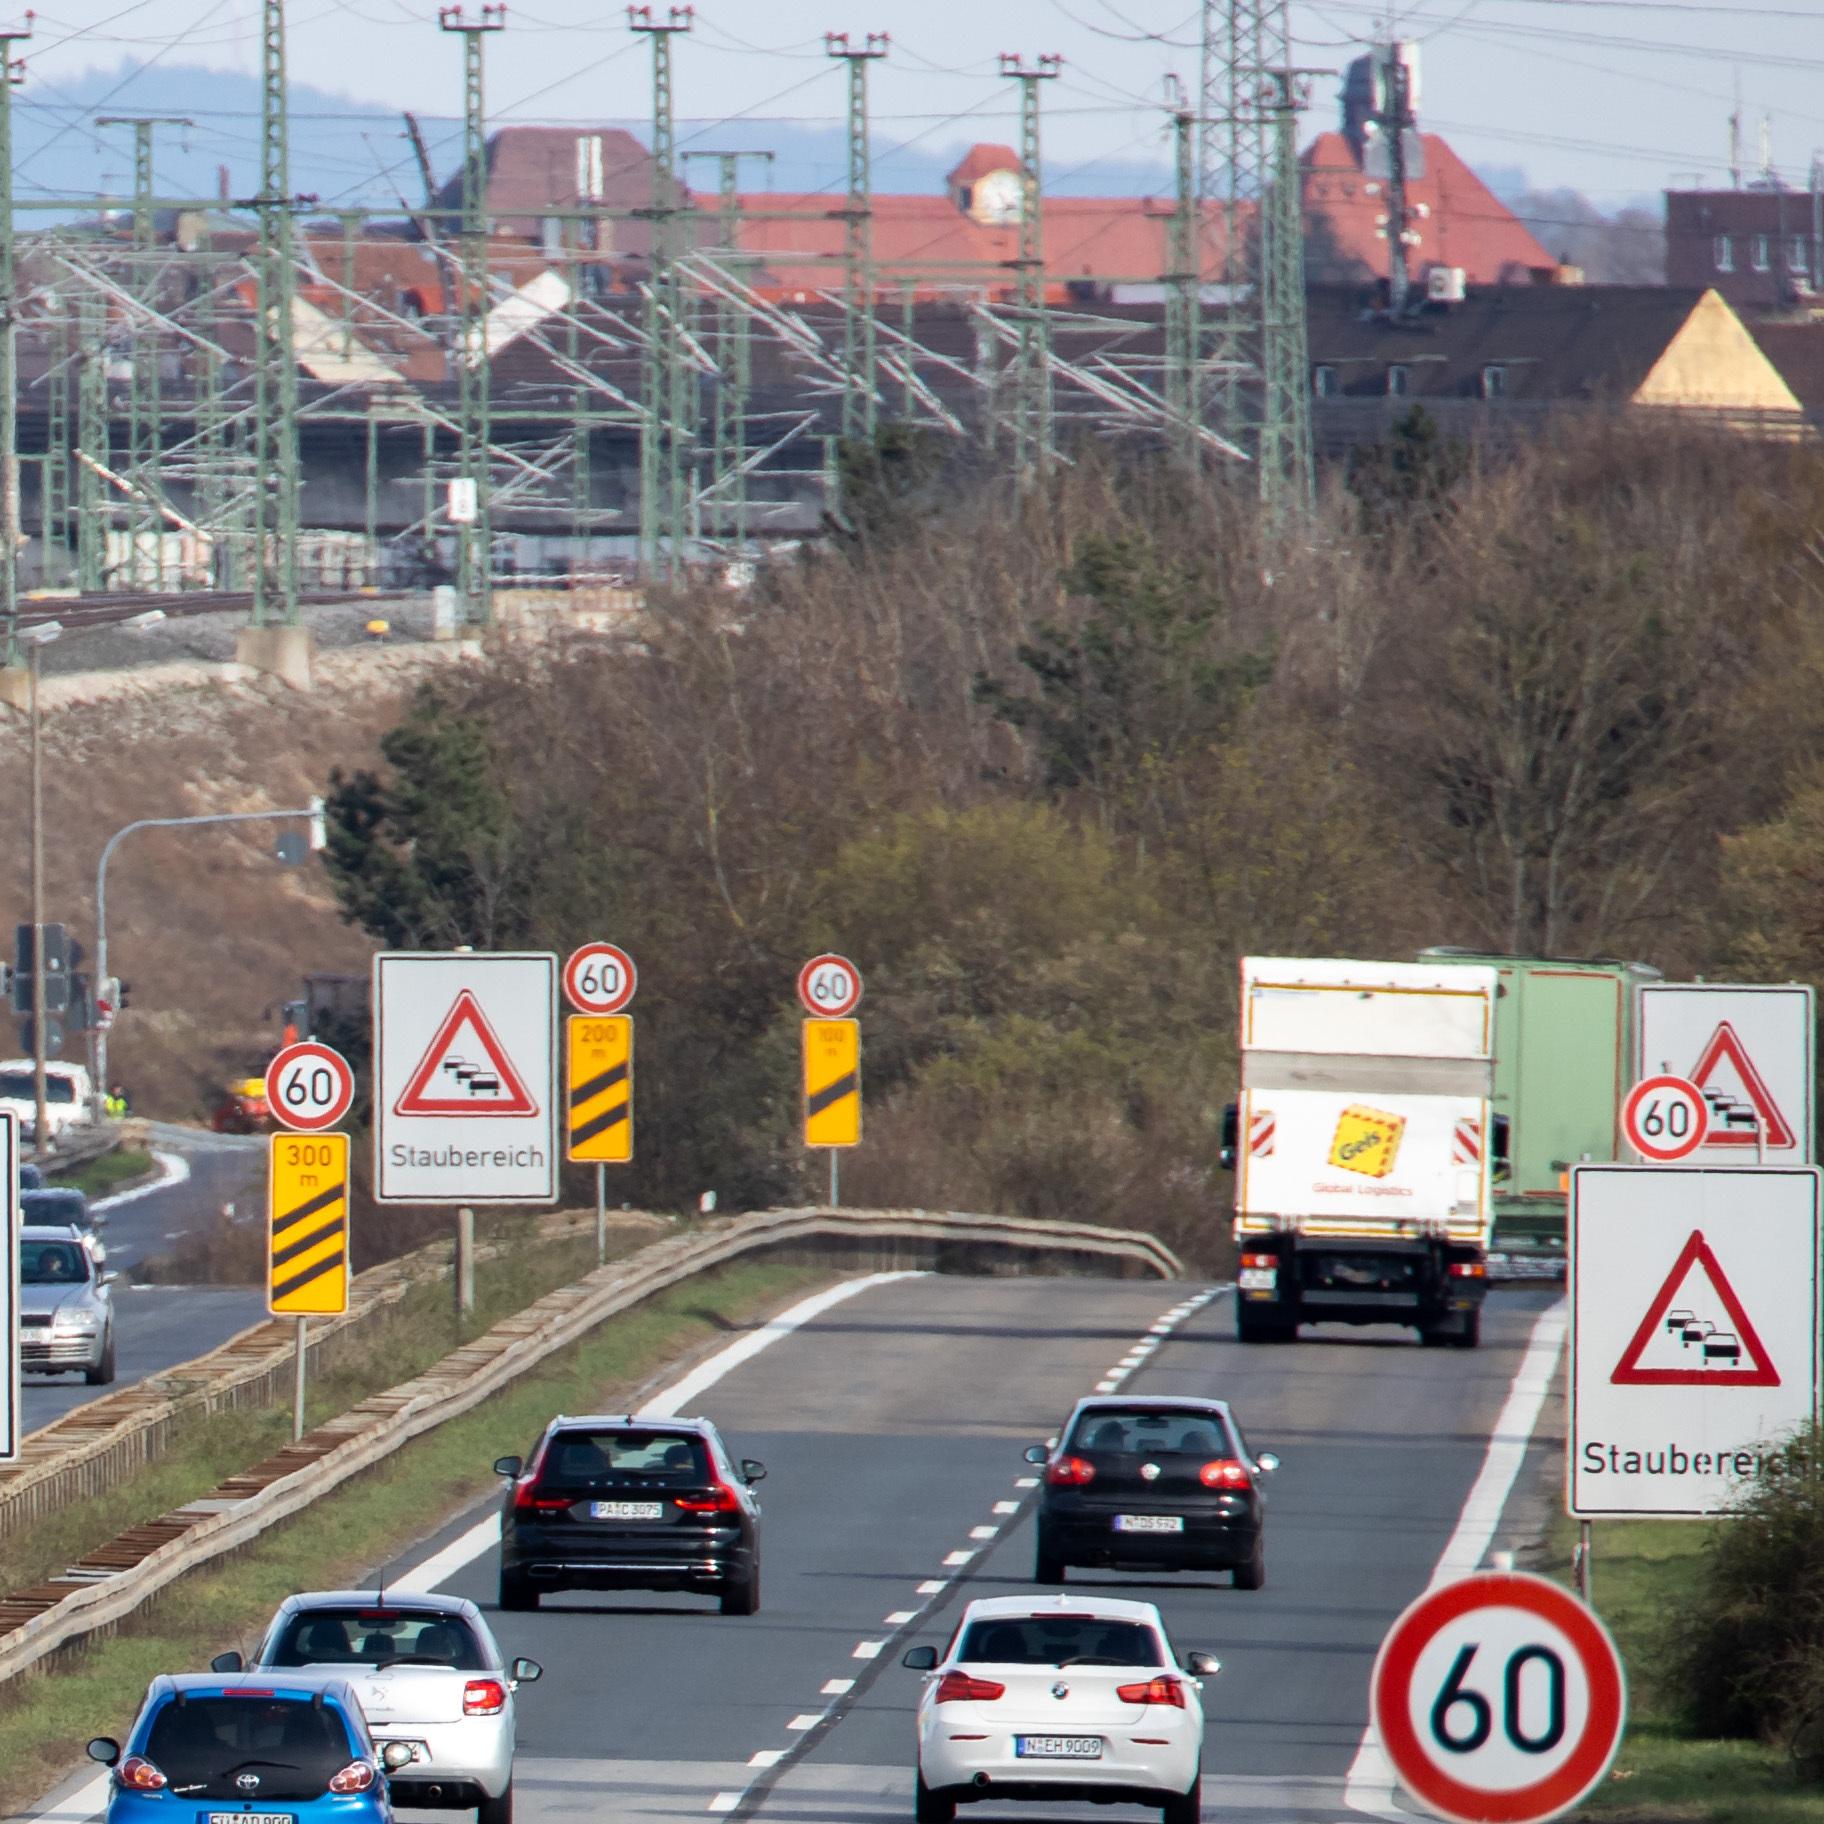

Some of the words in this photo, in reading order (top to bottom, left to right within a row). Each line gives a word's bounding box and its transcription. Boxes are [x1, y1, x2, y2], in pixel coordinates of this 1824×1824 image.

[582, 964, 619, 994] 60
[815, 972, 847, 1000] 60
[581, 1025, 618, 1042] 200
[286, 1067, 333, 1105] 60
[1644, 1101, 1689, 1137] 60
[287, 1145, 332, 1167] 300
[391, 1144, 544, 1168] Staubereich
[300, 1173, 319, 1187] m
[1430, 1642, 1566, 1754] 60
[1045, 1739, 1063, 1753] EH
